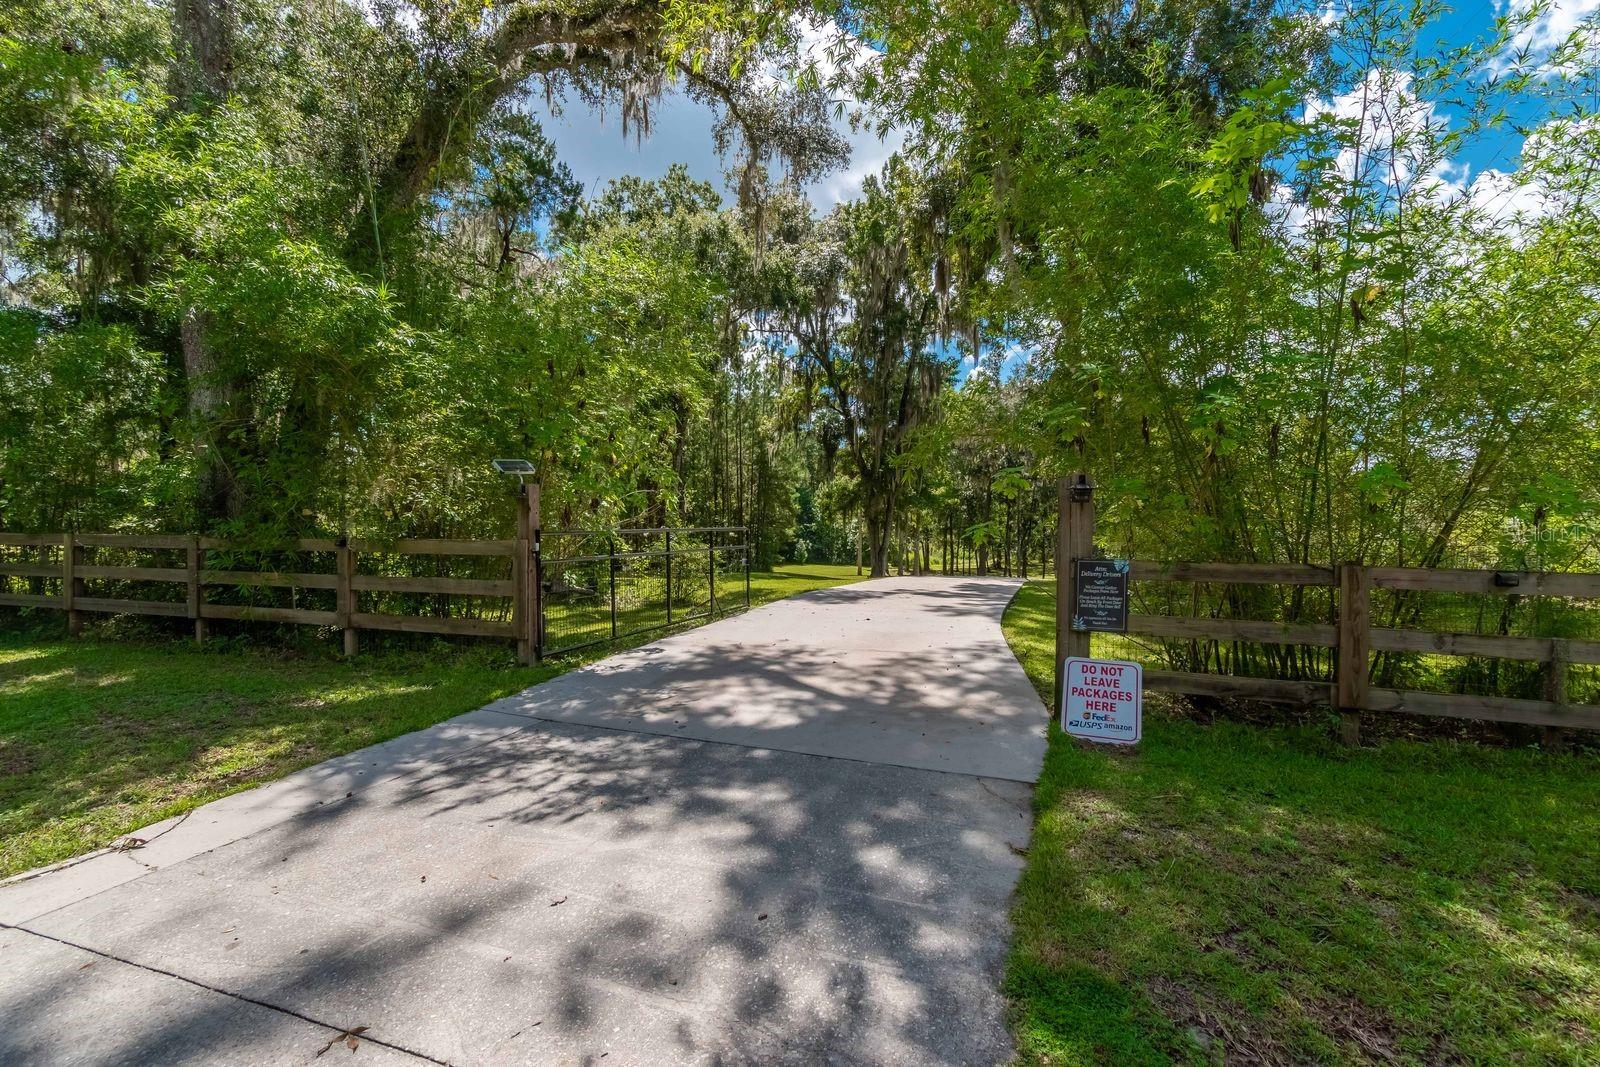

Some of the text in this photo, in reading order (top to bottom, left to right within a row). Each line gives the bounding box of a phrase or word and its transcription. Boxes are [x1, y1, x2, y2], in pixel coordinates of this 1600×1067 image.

[1081, 664, 1124, 676] DO NOT
[1084, 676, 1120, 688] LEAVE
[1072, 687, 1133, 702] PACKAGES
[1086, 700, 1117, 712] HERE
[1092, 713, 1116, 722] FedEx
[1080, 721, 1103, 729] USPS
